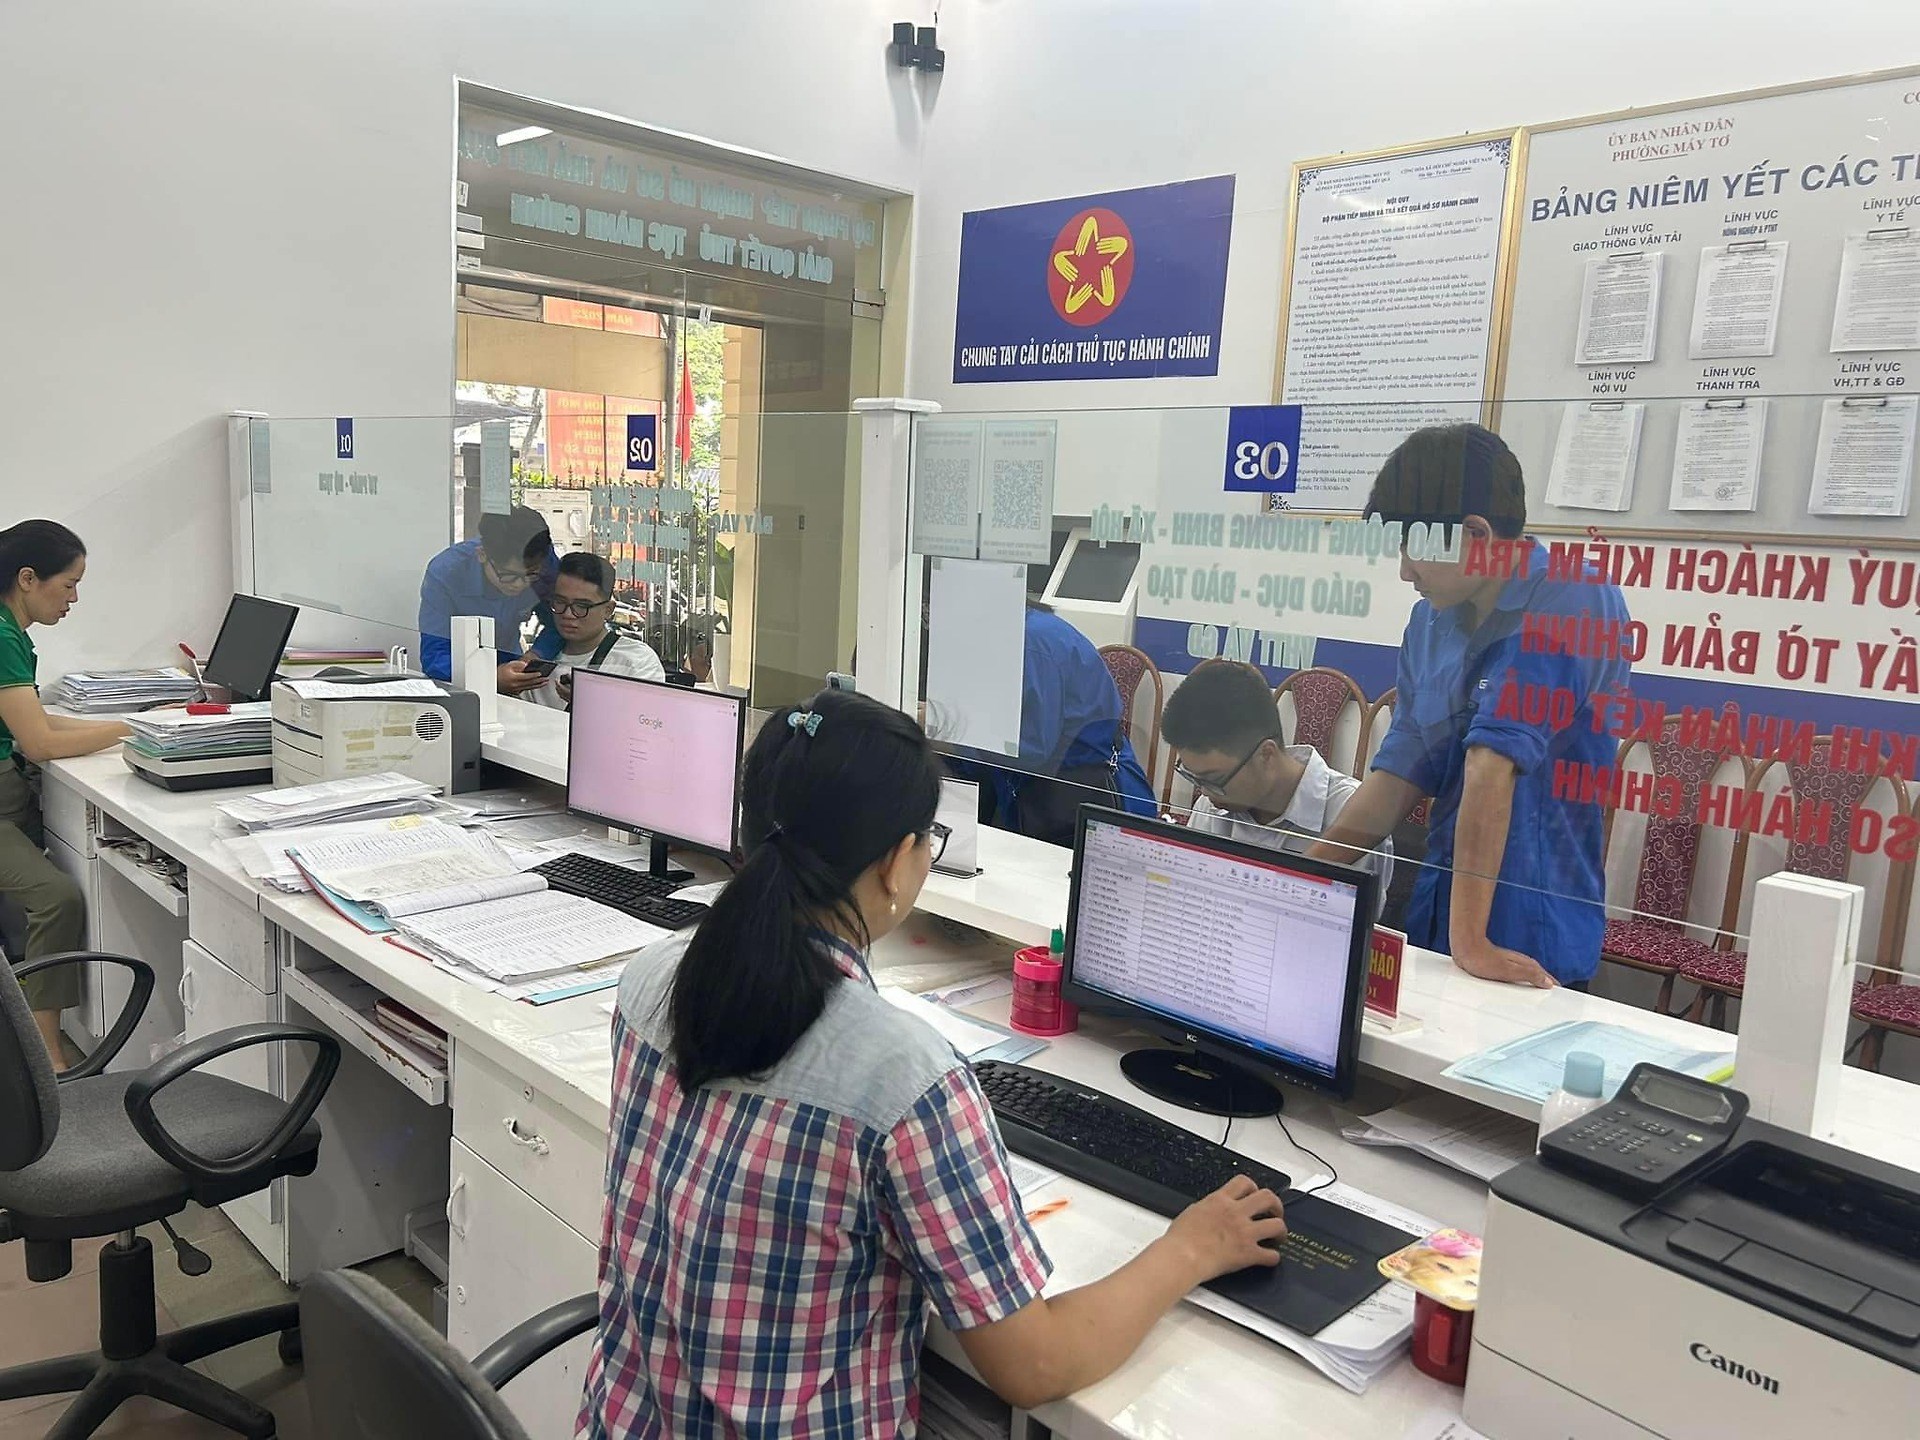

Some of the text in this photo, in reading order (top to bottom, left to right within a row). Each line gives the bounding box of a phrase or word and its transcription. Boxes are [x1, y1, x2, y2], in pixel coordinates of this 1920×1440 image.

[1608, 118, 1735, 148] ỦY BAN NHÂN DÂN
[1612, 135, 1731, 161] PHƯỜNG MÁY TƠ
[1531, 186, 1616, 221] BẢNG
[1628, 177, 1708, 210] NIÊM
[1723, 158, 1789, 200] YẾT
[1801, 154, 1878, 192] CÁC
[1863, 198, 1892, 210] LĨNH
[1725, 209, 1779, 223] LĨNH VỰC
[1877, 208, 1905, 222] Y TẾ
[1605, 223, 1653, 236] LĨNH VỰC
[1573, 231, 1682, 252] GIAO THÔNG VẬN TẢI
[961, 331, 1210, 367] CHUNG TAY CẢI CÁCH THỦ TỤC HÀNH CHÍNH
[1703, 366, 1755, 378] LĨNH VỰC
[1841, 360, 1900, 373] LĨNH VỰC
[1588, 369, 1636, 381] LĨNH VỰC
[1873, 376, 1882, 386] &
[1886, 375, 1904, 386] GĐ
[1593, 382, 1627, 395] NỘI VỤ
[1697, 378, 1760, 391] THANH TRA
[638, 714, 663, 730] Google
[1186, 1033, 1198, 1043] KC
[1689, 1342, 1780, 1395] Canon
